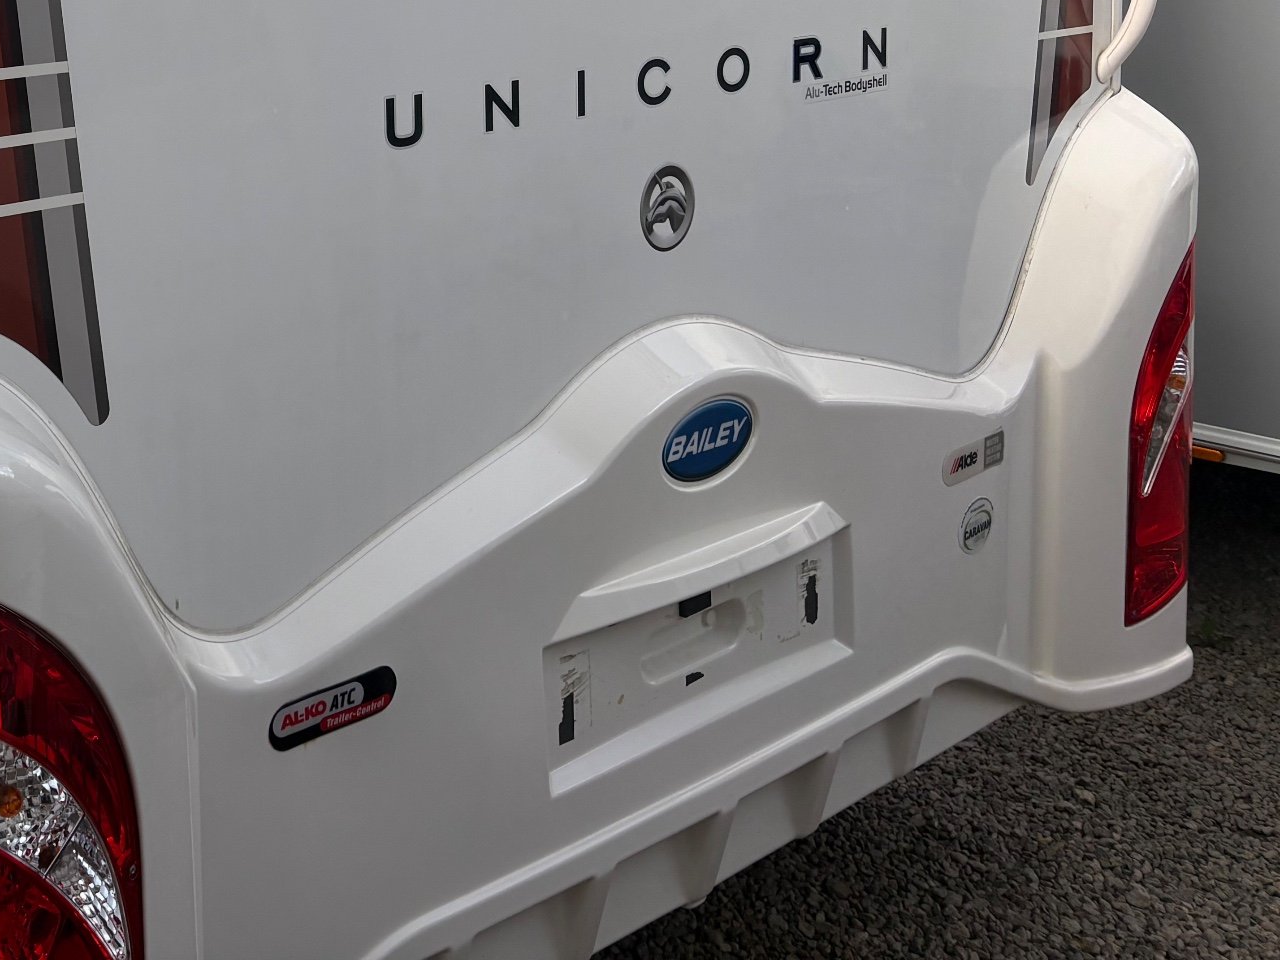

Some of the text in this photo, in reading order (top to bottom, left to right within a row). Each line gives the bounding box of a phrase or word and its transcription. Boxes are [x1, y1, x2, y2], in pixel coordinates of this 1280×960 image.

[384, 27, 888, 148] UNICORN
[805, 74, 888, 100] Alu-Tech Bodyshell
[666, 416, 748, 463] BAILEY
[280, 687, 357, 731] AL-KO ATC
[326, 696, 385, 728] Trailer-Control
